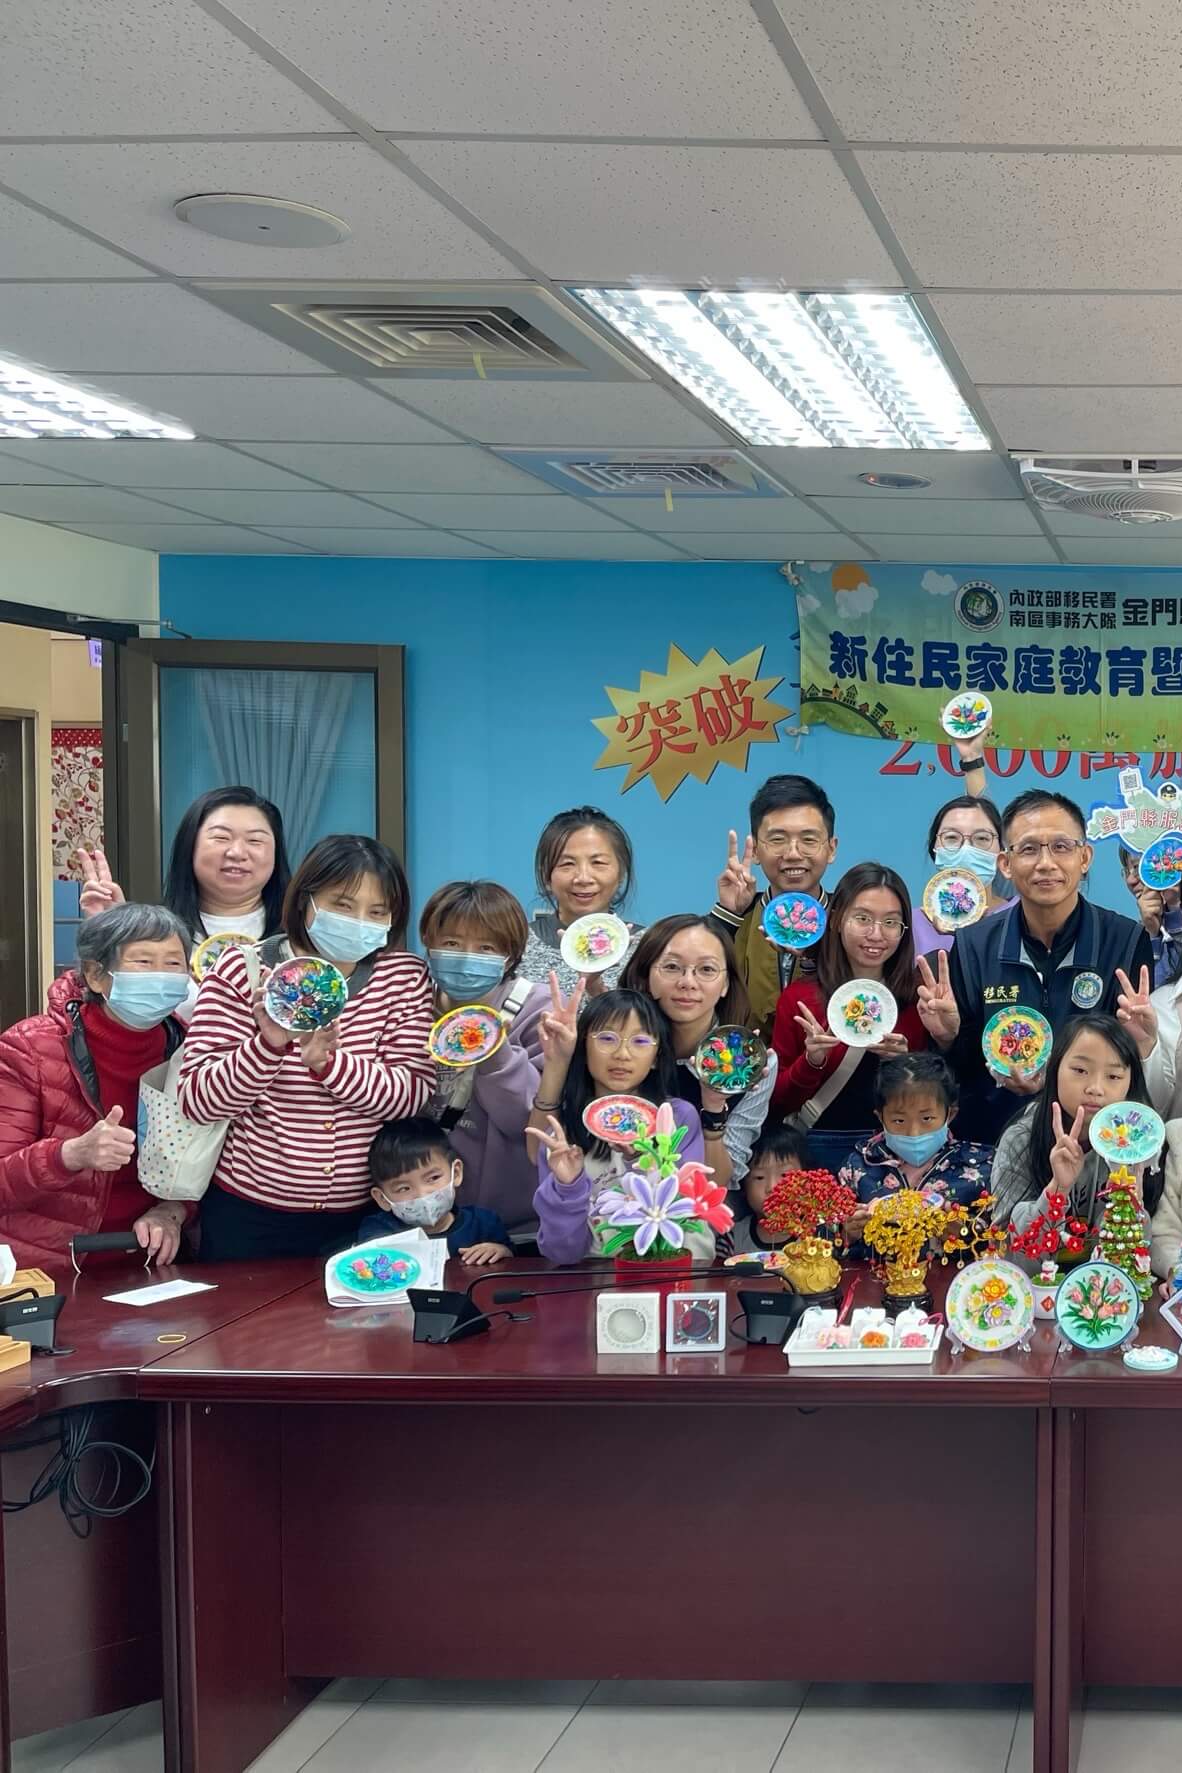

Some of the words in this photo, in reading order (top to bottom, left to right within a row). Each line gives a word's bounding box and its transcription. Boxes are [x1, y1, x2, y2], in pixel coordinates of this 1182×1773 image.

[1009, 589, 1116, 609] 內政部移民署
[1009, 610, 1117, 630] 南區事務大隊
[616, 674, 768, 773] 突破
